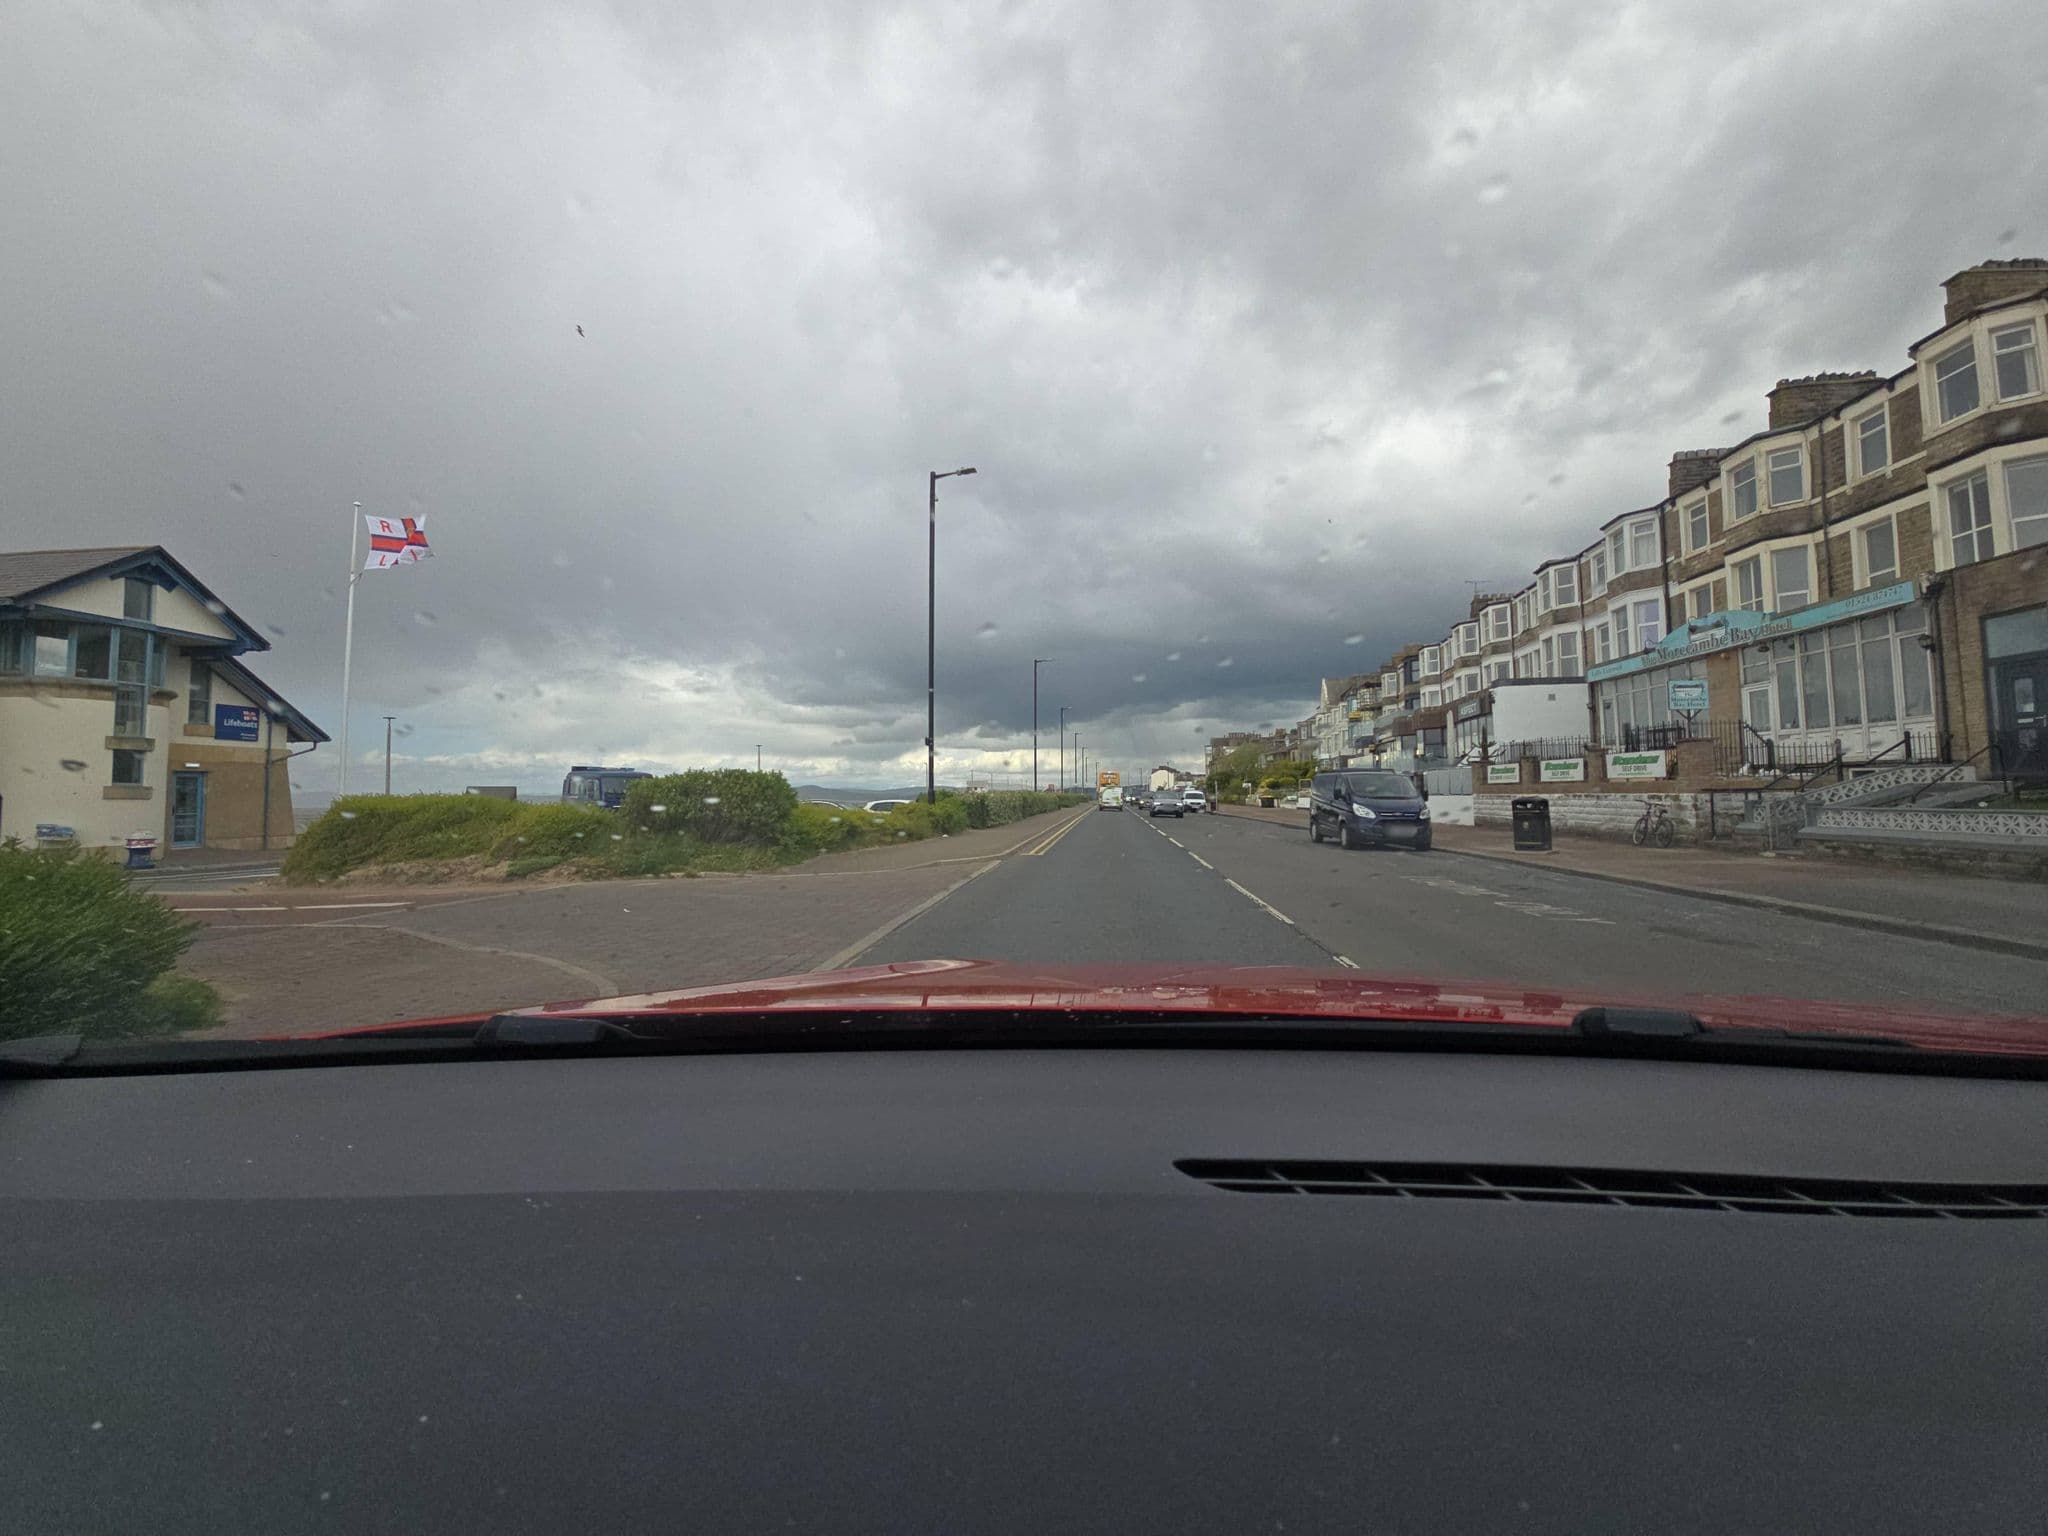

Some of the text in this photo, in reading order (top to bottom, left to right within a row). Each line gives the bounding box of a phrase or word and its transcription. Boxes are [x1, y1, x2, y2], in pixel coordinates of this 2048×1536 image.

[379, 519, 393, 533] R
[1657, 633, 1729, 661] Morecambe
[1729, 626, 1760, 645] Bay
[223, 718, 258, 729] Lifeboats
